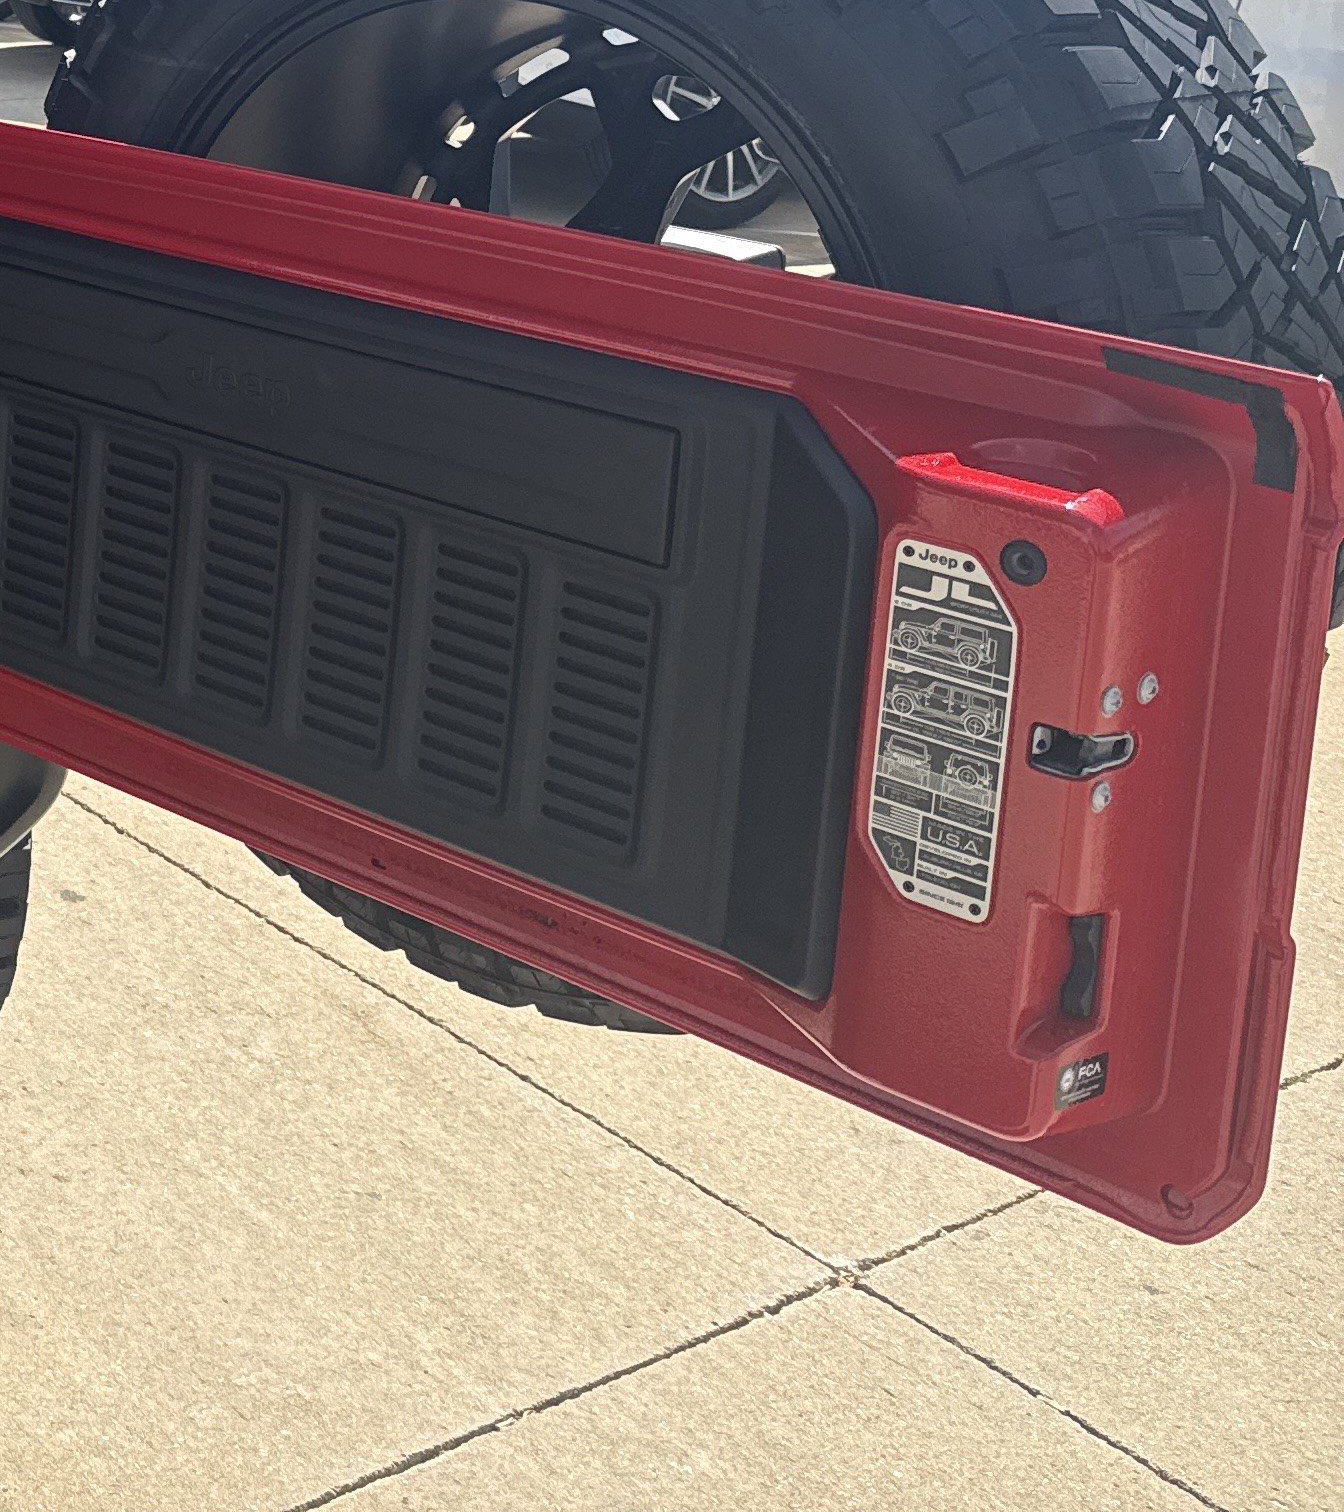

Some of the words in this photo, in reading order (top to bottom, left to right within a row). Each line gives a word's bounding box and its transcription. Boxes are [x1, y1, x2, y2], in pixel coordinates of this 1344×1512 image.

[185, 351, 291, 416] Jeep
[918, 548, 958, 569] Jeep
[899, 575, 998, 610] JL
[927, 826, 983, 857] U.S.A.
[1077, 1061, 1102, 1080] FCA
